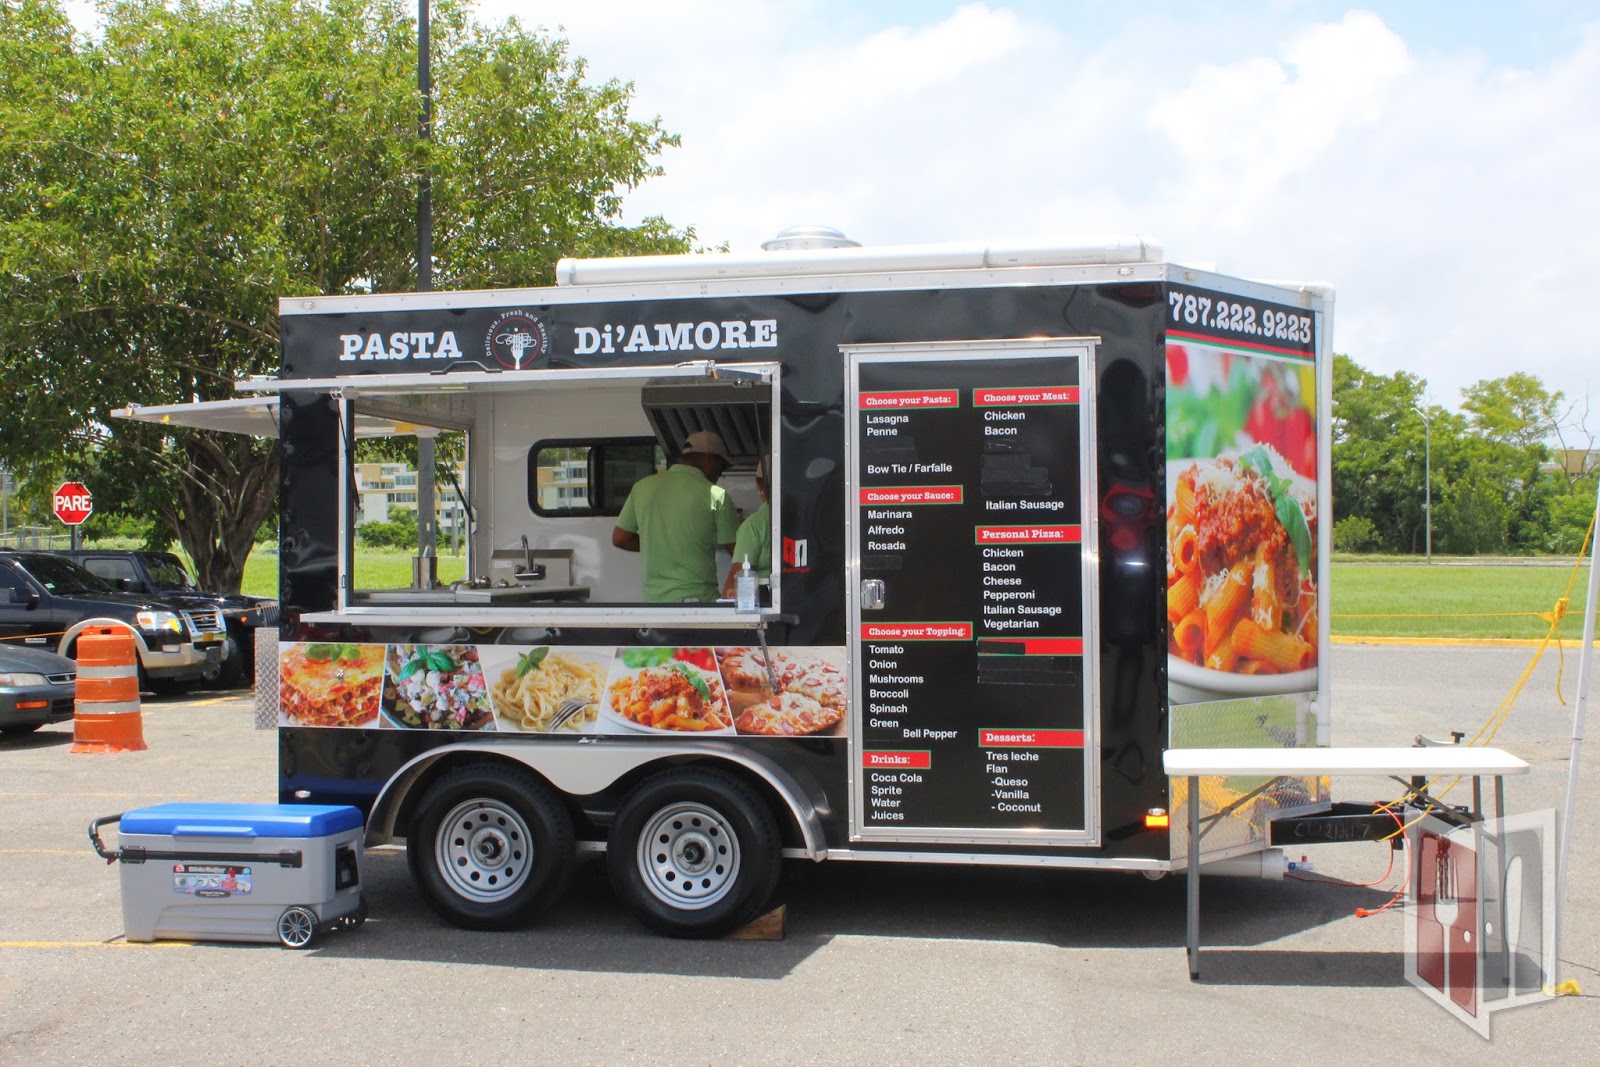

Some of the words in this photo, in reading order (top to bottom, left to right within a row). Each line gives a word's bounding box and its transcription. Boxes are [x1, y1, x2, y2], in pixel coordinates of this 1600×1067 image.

[1169, 291, 1311, 344] 787.222.9223
[501, 310, 522, 319] Fresh
[525, 313, 538, 322] and
[537, 322, 548, 354] Healthy
[339, 331, 463, 361] PASTA
[574, 319, 778, 355] Di'AMORE
[899, 398, 921, 407] your
[922, 396, 951, 405] Pasta:
[984, 394, 1016, 402] Choose
[1018, 395, 1040, 403] your
[1042, 393, 1070, 402] Meat:
[867, 415, 908, 425] Lasagna
[985, 411, 1025, 420] Chicken
[867, 428, 897, 436] Penne
[985, 427, 1017, 435] Bacon
[868, 465, 889, 473] Bow
[891, 464, 906, 473] Tie
[915, 463, 952, 472] Farfalle
[901, 494, 922, 502] your
[924, 492, 954, 501] Sauce:
[55, 495, 91, 511] PARE
[986, 501, 1017, 509] Italian
[1020, 500, 1064, 510] Sausage
[868, 510, 912, 519] Marinara
[868, 526, 904, 534] Alfredo
[983, 530, 1029, 538] Personal
[1032, 529, 1063, 538] Pizza:
[869, 541, 905, 550] Rosada
[983, 549, 1023, 557] Chicken
[983, 563, 1015, 571] Bacon
[983, 577, 1021, 585] Cheese
[984, 590, 1035, 601] Pepperoni
[984, 605, 1015, 614] Italian
[1018, 605, 1061, 616] Sausage
[984, 619, 1039, 630] Vegetarian
[902, 629, 924, 637] your
[926, 627, 965, 636] Topping:
[869, 645, 903, 653] Tomato
[870, 660, 897, 668] Onion
[870, 675, 923, 683] Mushrooms
[870, 689, 908, 698] Broccoli
[870, 704, 907, 714] Spinach
[870, 719, 898, 727] Green
[904, 729, 920, 737] Bell
[924, 729, 957, 740] Pepper
[986, 733, 1035, 742] Desserts:
[871, 755, 909, 764] Drinks:
[986, 752, 1008, 760] Tres
[1011, 752, 1039, 761] leche
[987, 764, 1007, 773] Flan
[871, 773, 897, 782] Coca
[900, 774, 922, 782] Cola
[872, 786, 902, 796] Sprite
[871, 798, 901, 807] Water
[871, 811, 904, 819] Juices
